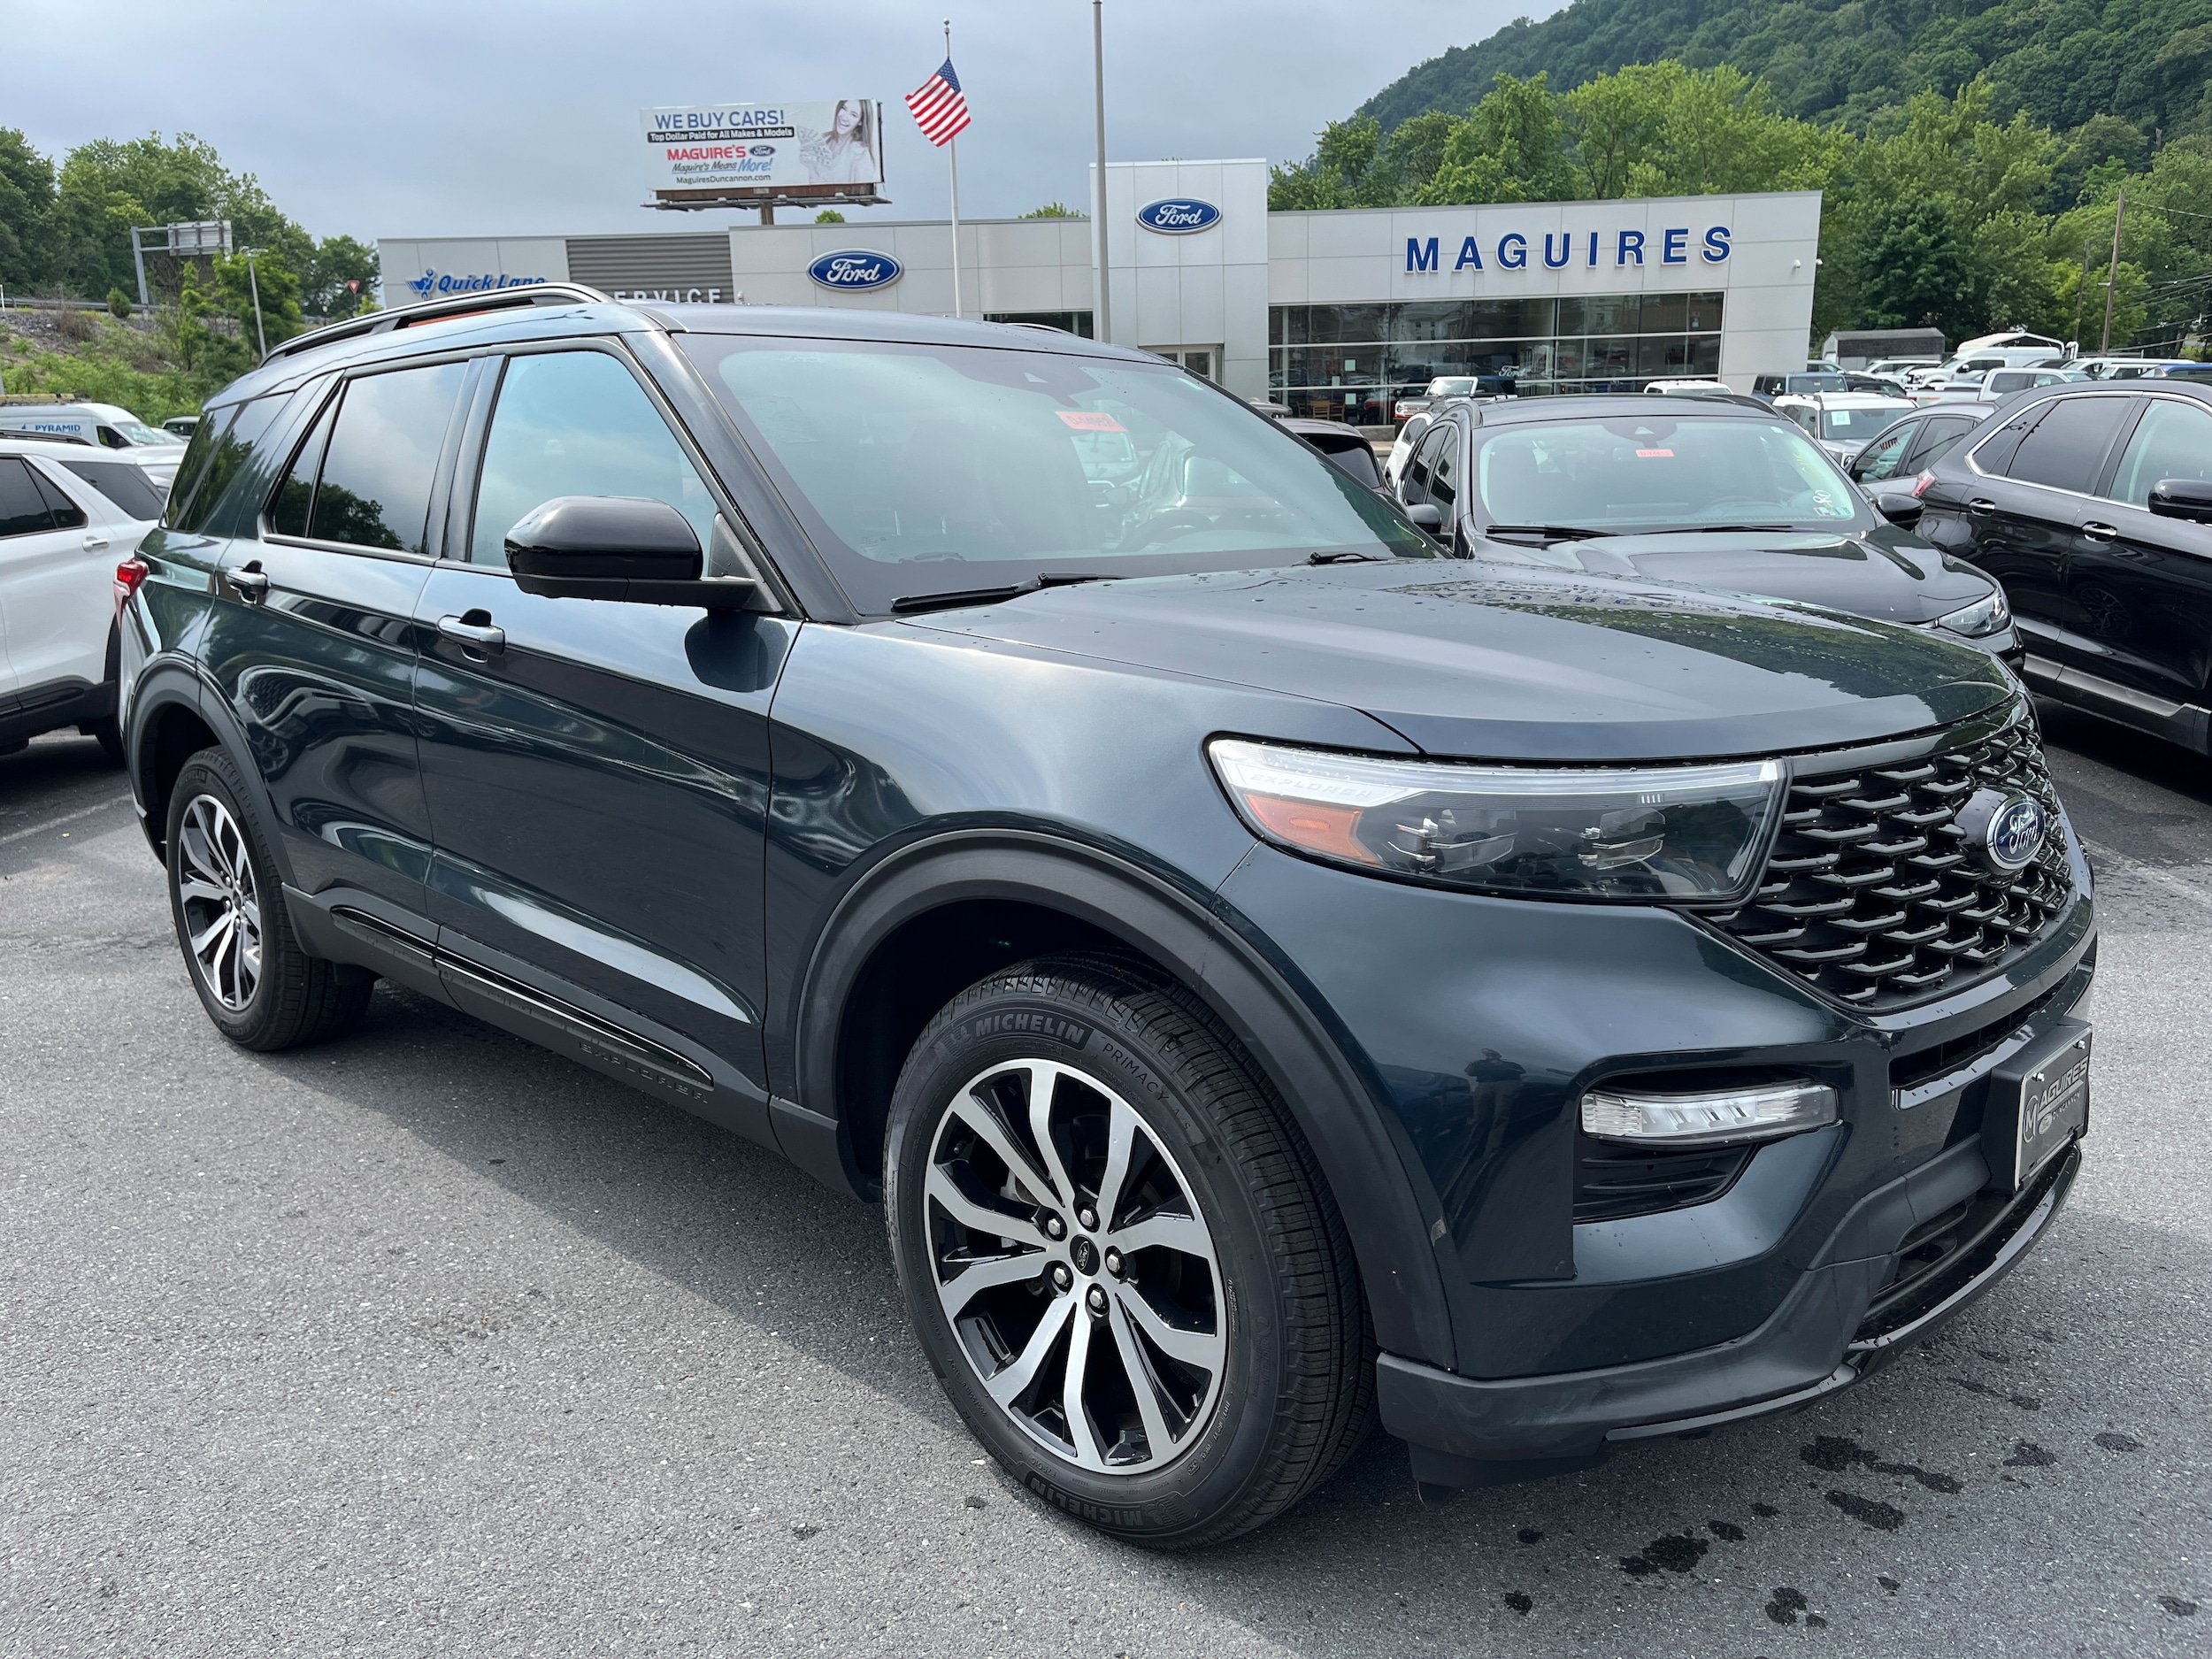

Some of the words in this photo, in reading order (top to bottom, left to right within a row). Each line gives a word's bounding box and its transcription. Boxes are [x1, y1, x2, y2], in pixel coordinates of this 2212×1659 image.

[655, 114, 683, 129] WE
[687, 111, 725, 128] BUY
[728, 110, 785, 127] CARS!
[650, 133, 664, 142] Top
[665, 132, 687, 141] Dollar
[689, 131, 706, 140] Paid
[708, 130, 718, 139] for
[731, 129, 756, 138] Makes
[757, 128, 763, 137] &
[667, 144, 746, 161] MAGUIRE'S
[672, 161, 710, 174] Maguire's
[711, 161, 737, 171] Means
[737, 157, 772, 173] More!
[676, 174, 772, 184] MaguiresDuncannon.com
[1155, 204, 1202, 225] Ford
[1405, 226, 1732, 273] MAGUIRES
[825, 257, 880, 282] Ford
[438, 274, 493, 292] Quick
[1498, 365, 1526, 377] Ford
[1250, 773, 1371, 797] EXPLORER
[975, 1013, 1086, 1044] MICHELIN
[1102, 1042, 1169, 1102] PRIMACY
[1029, 1478, 1144, 1527] MICHELIN
